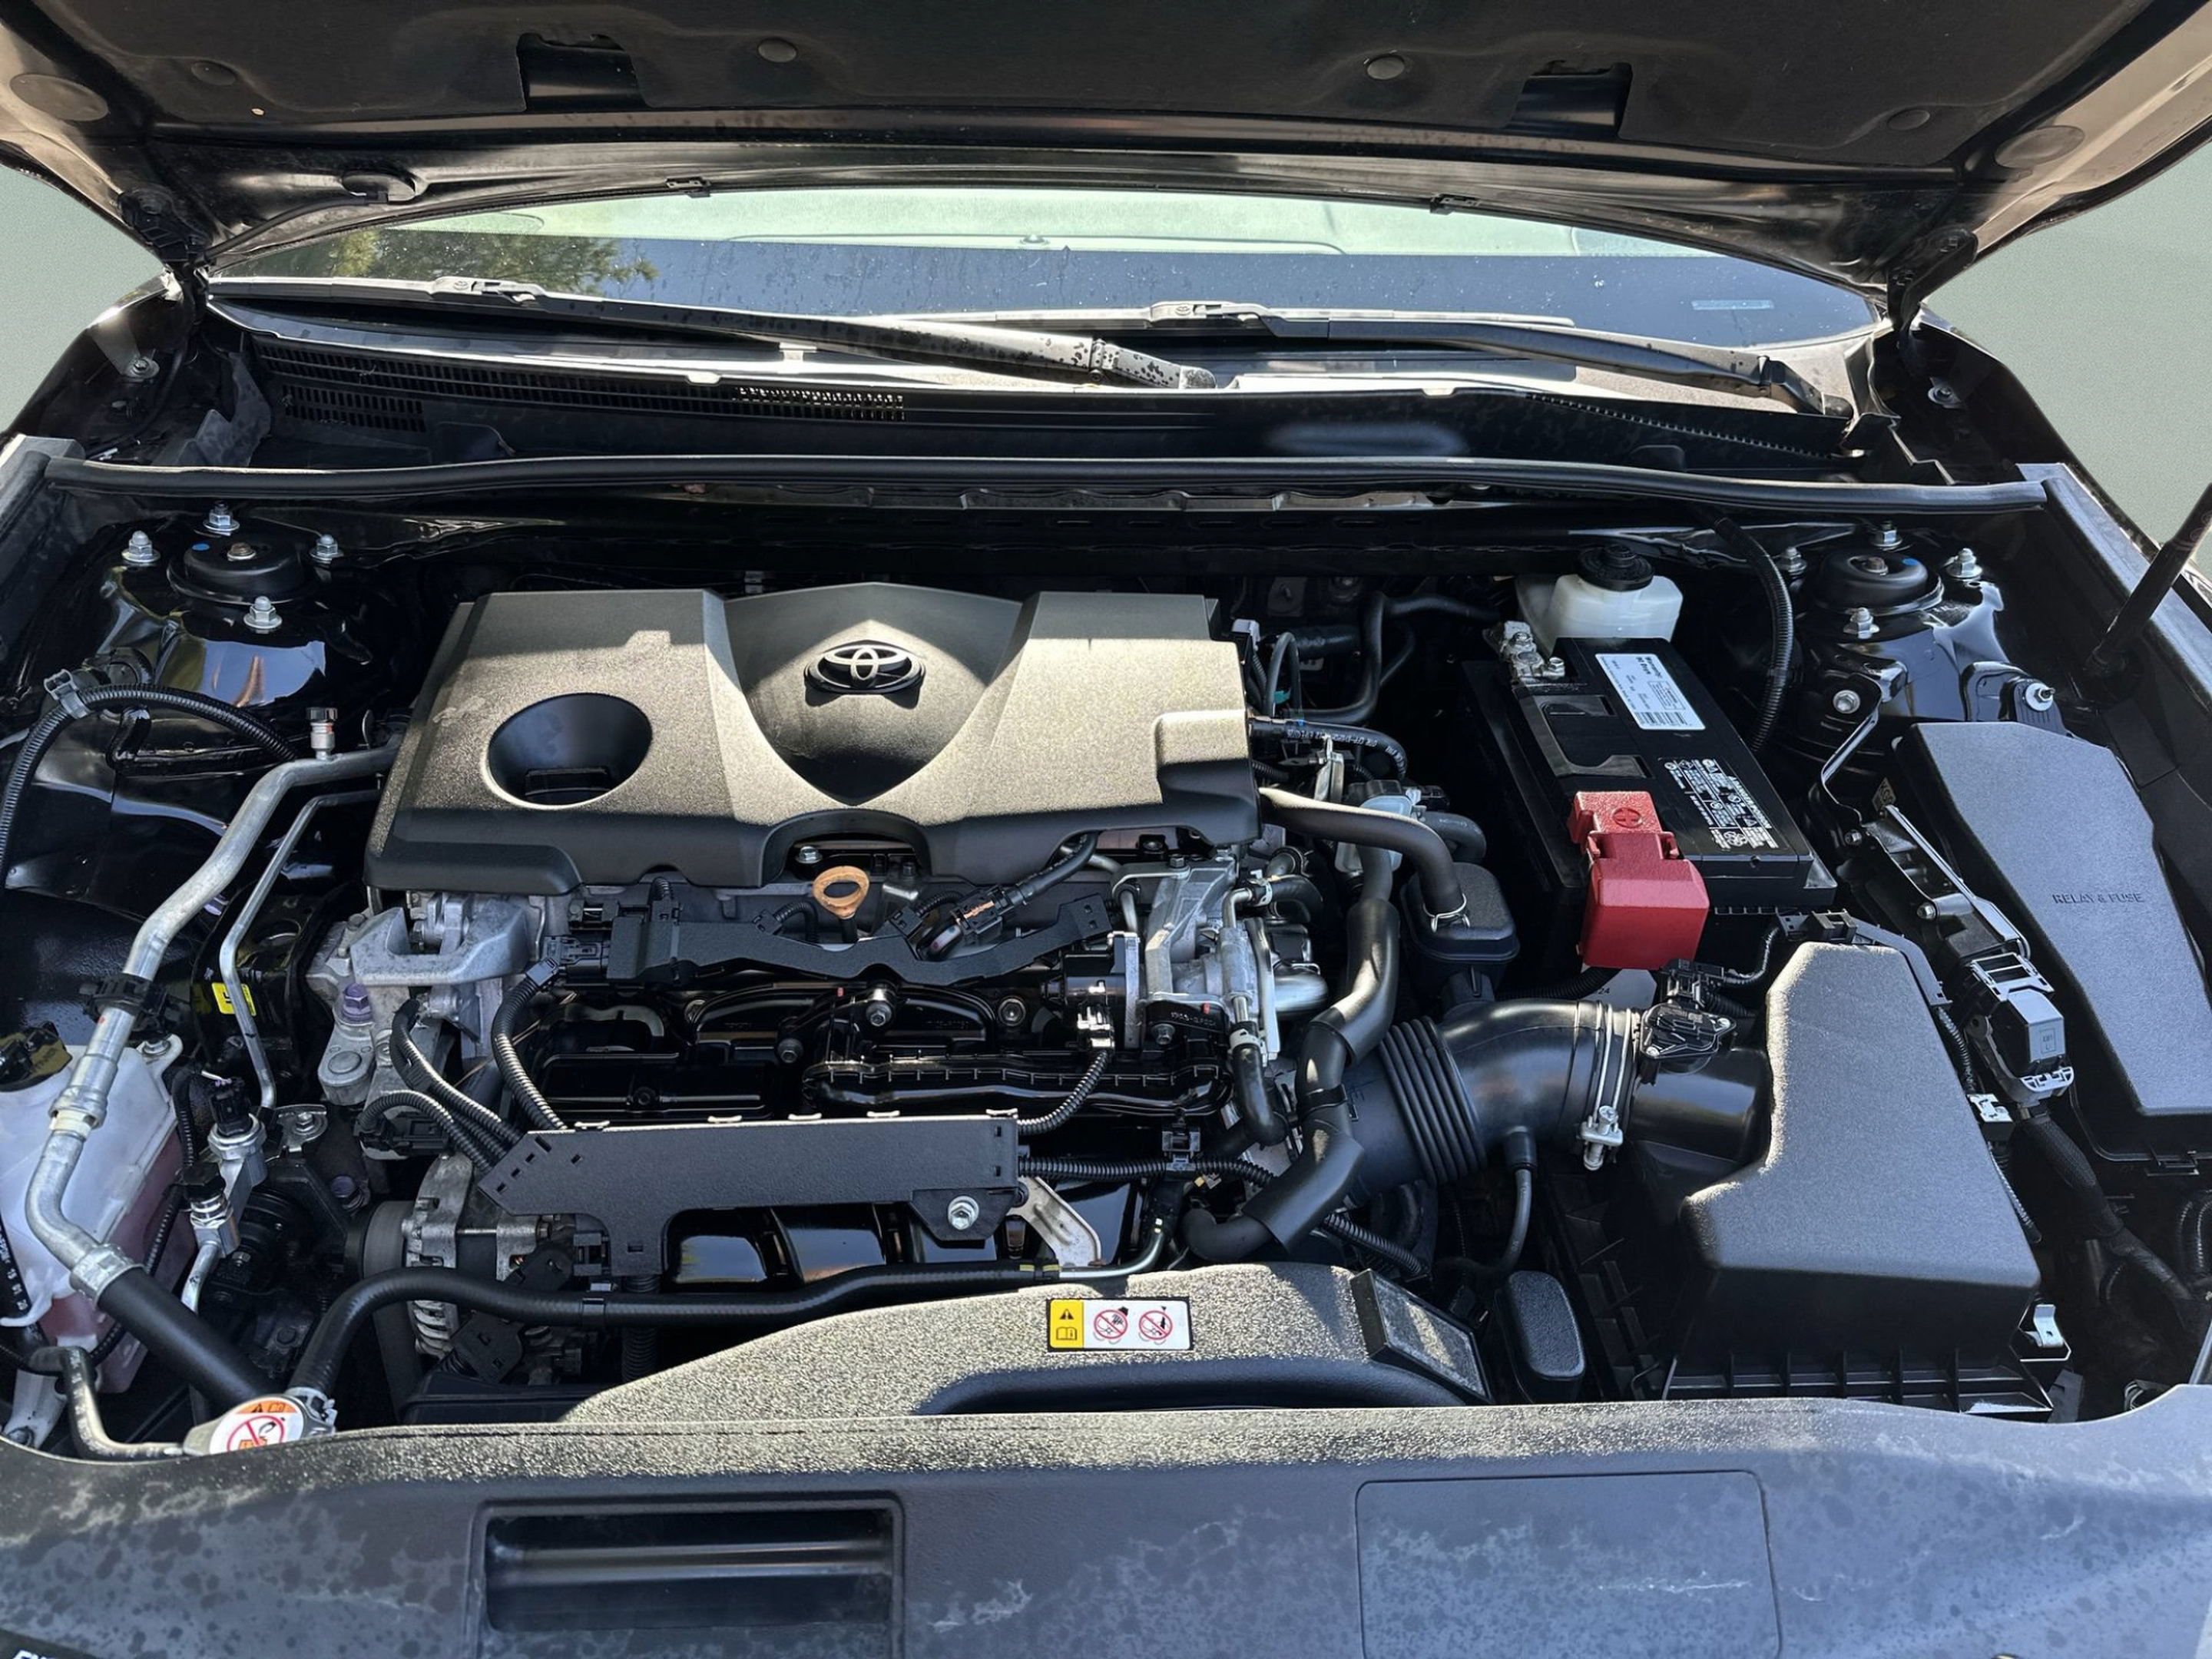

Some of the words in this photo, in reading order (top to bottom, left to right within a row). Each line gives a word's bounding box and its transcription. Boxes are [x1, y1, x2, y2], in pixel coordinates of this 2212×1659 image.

[2052, 894, 2094, 903] RELAY
[2098, 894, 2108, 903] &
[2108, 893, 2145, 903] FUSE
